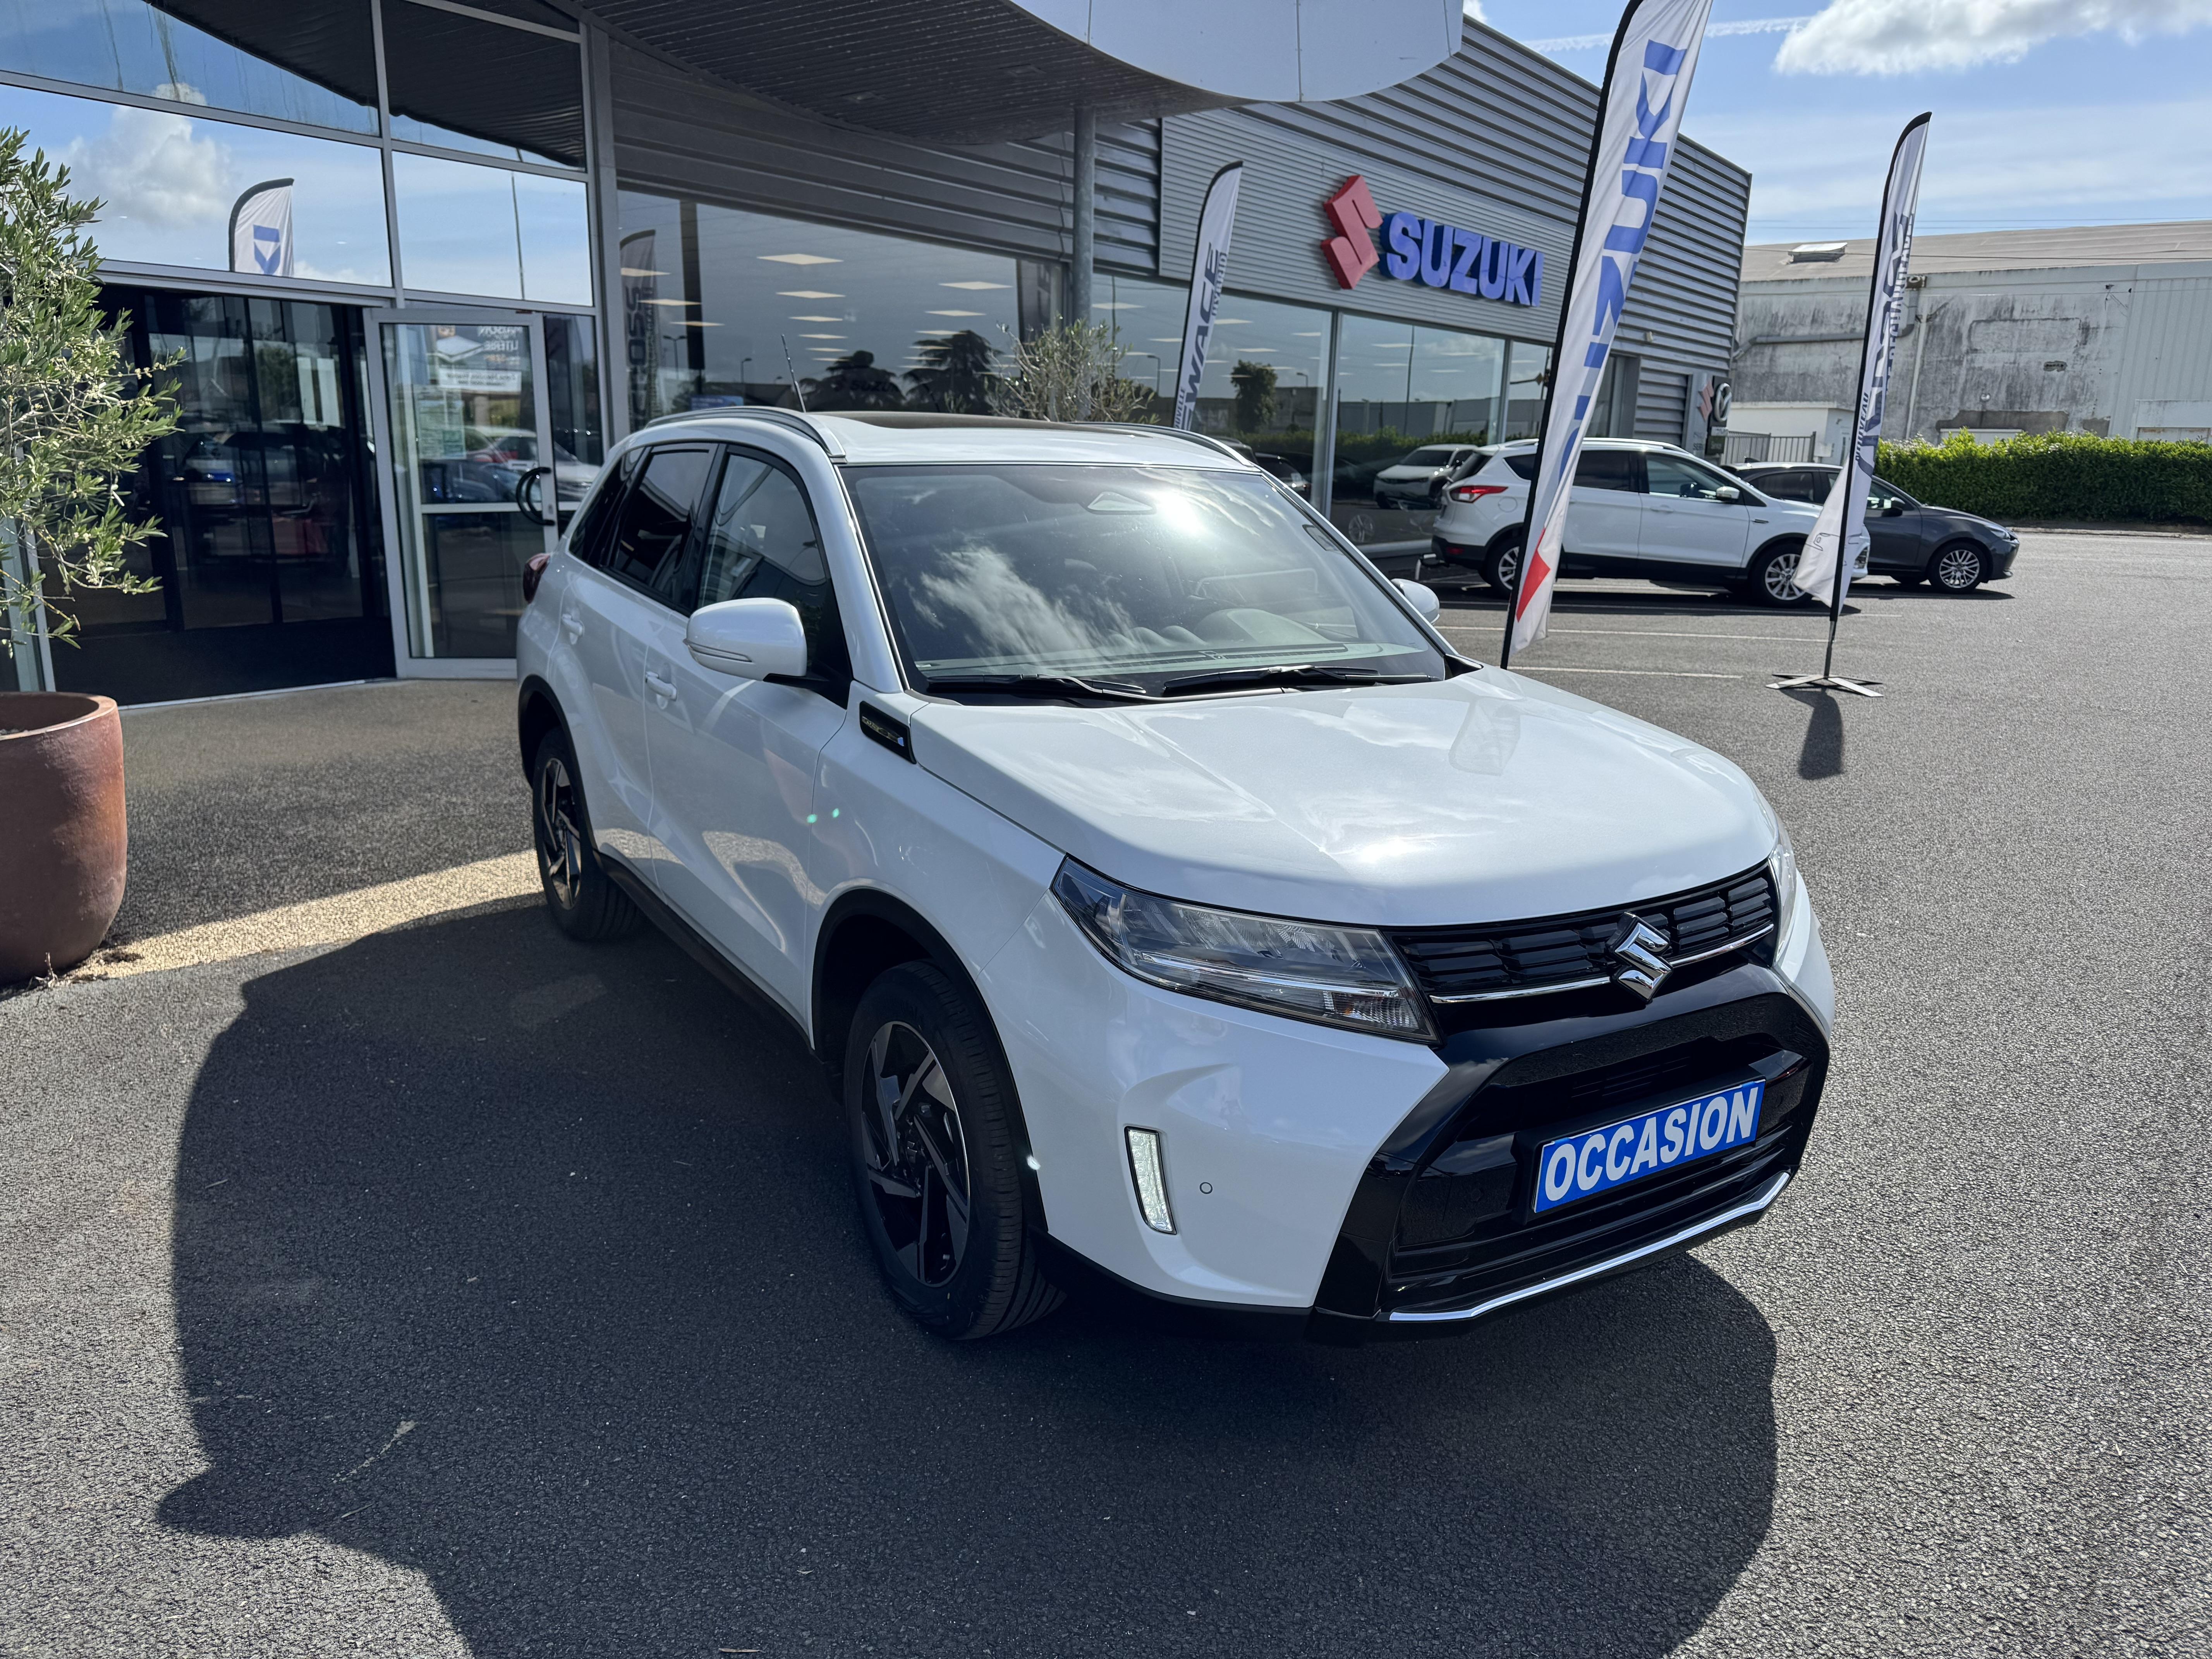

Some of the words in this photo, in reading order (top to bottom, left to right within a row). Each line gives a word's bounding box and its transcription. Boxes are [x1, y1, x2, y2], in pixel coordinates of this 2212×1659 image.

[1383, 211, 1544, 307] SUZUKI
[1889, 214, 1914, 360] RECHARGEAB
[1175, 387, 1185, 429] UVELLE
[1544, 1087, 1759, 1202] OCCASION
